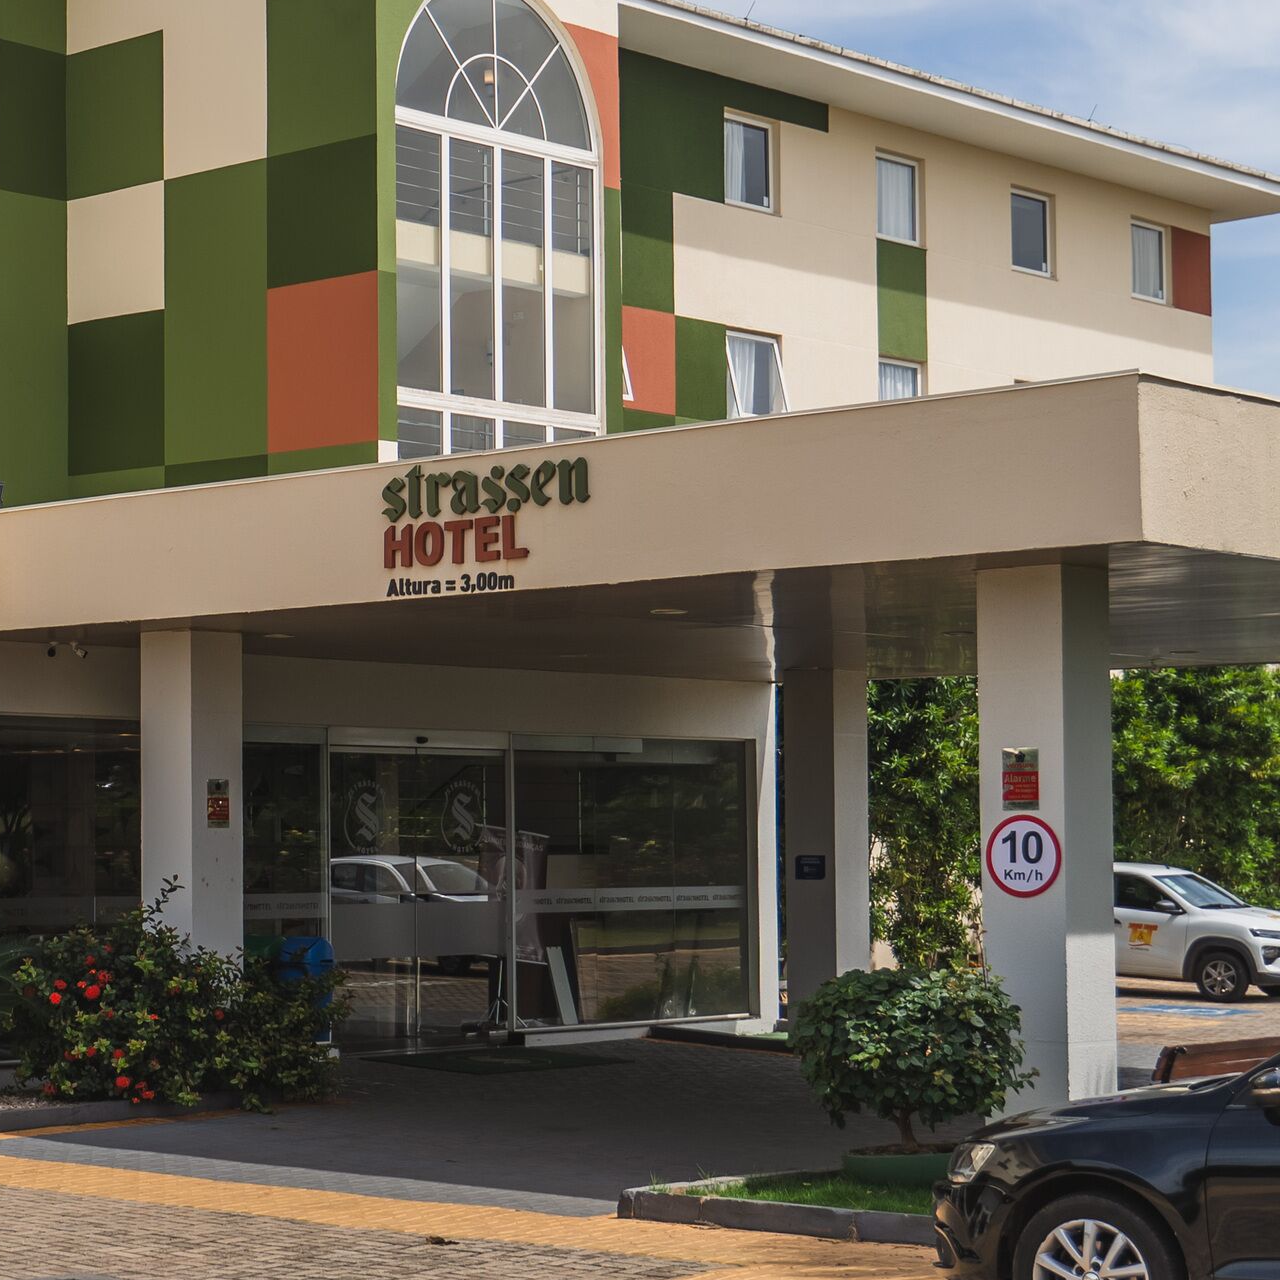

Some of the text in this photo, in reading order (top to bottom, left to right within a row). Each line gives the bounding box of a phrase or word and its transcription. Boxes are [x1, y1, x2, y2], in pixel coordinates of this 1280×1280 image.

[381, 457, 591, 523] strassen
[383, 515, 530, 569] HOTEL
[386, 577, 441, 597] Altura
[460, 572, 515, 594] 3,00m
[1004, 774, 1037, 784] Alarme
[1001, 830, 1044, 864] 10
[1004, 869, 1043, 883] Km/h
